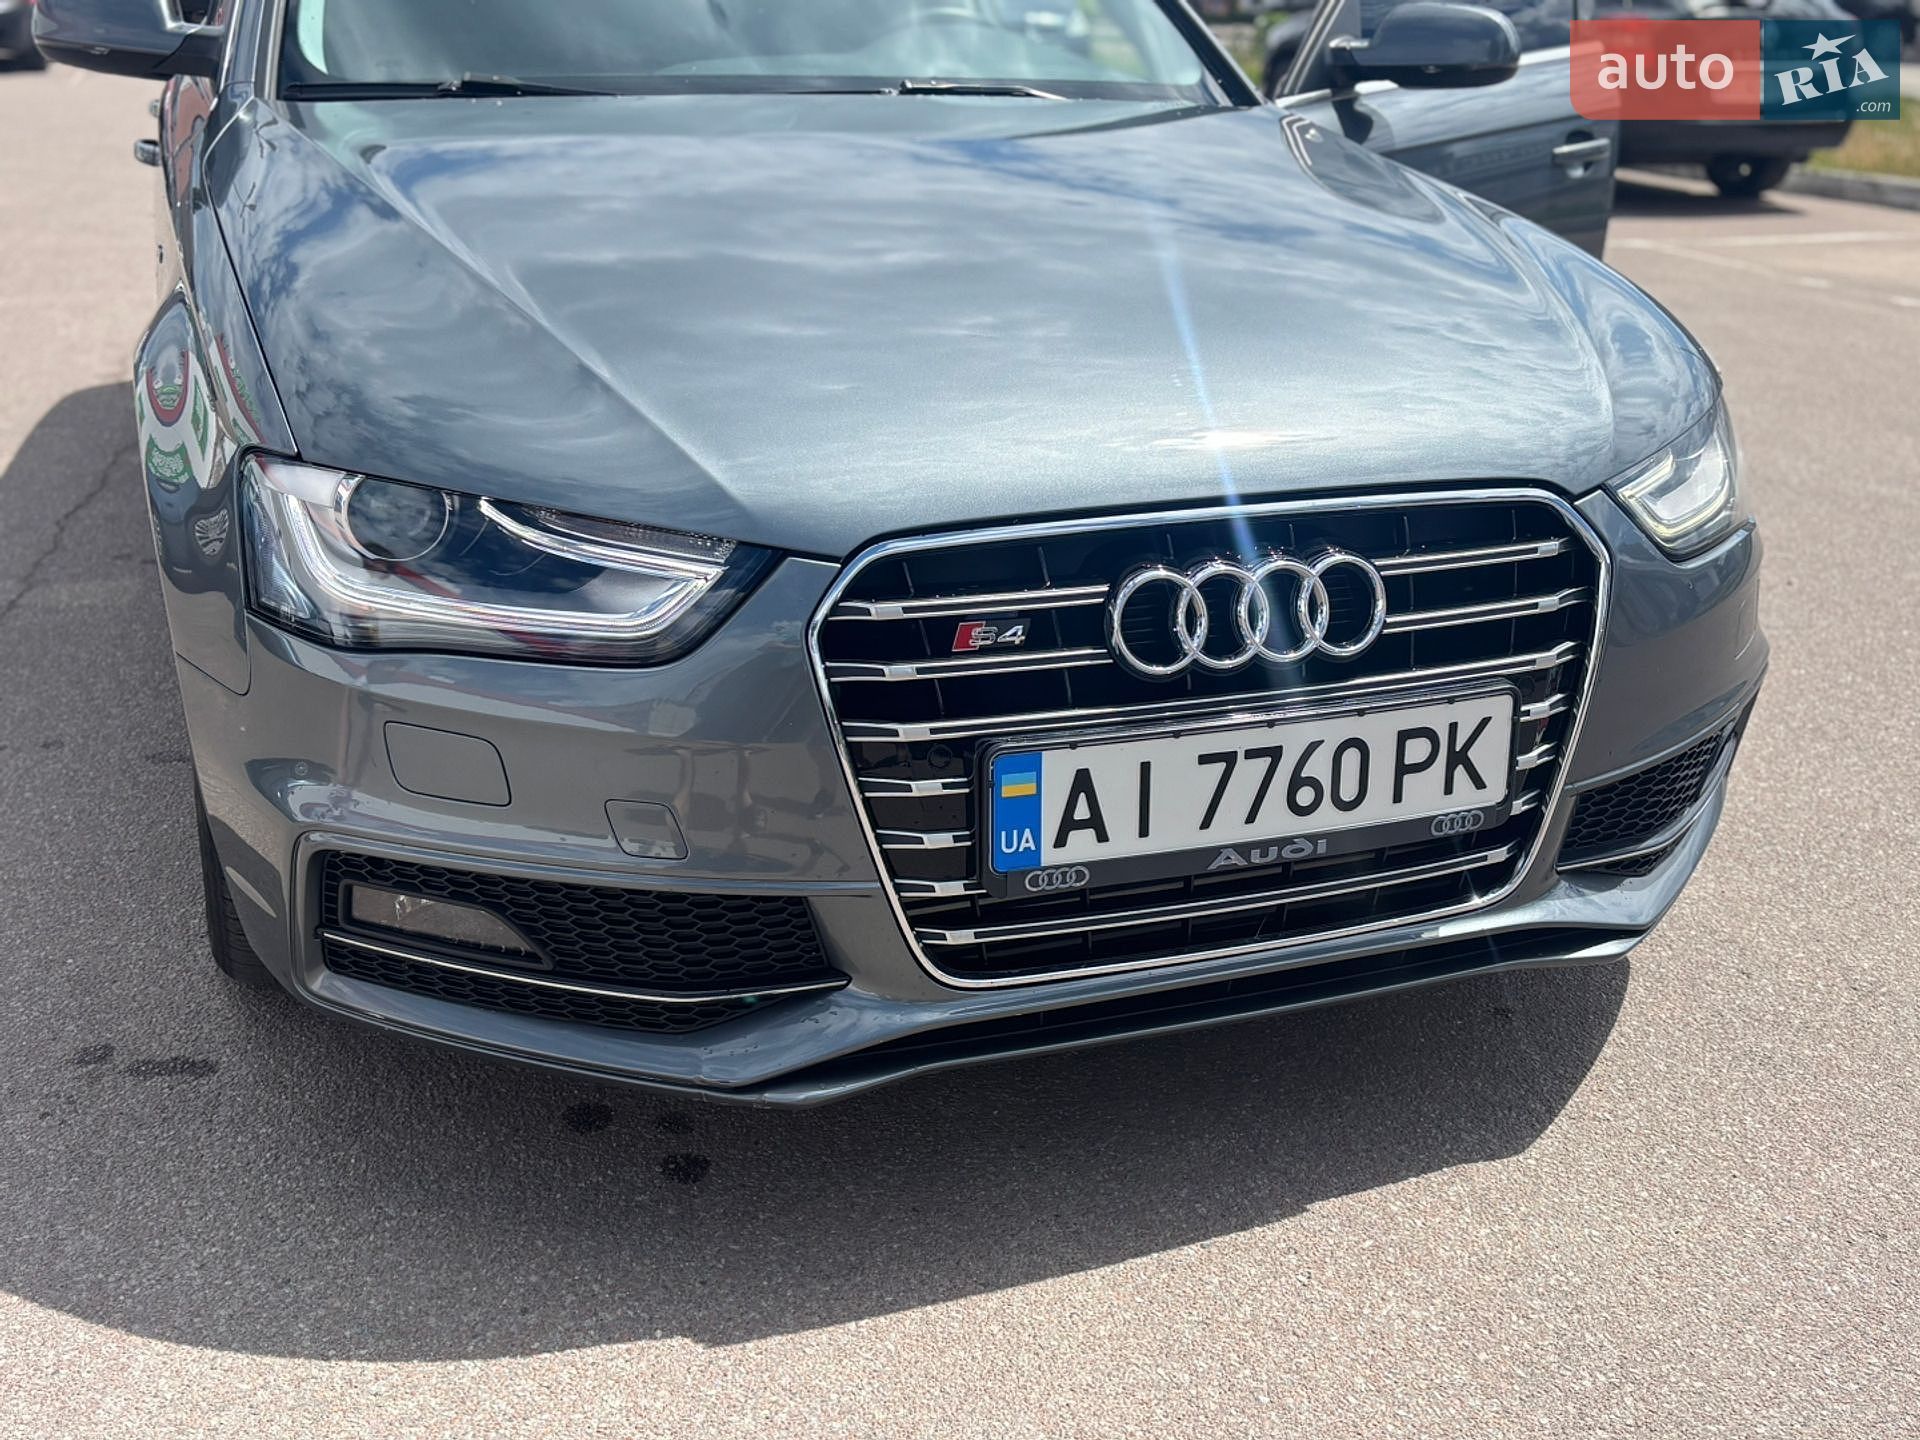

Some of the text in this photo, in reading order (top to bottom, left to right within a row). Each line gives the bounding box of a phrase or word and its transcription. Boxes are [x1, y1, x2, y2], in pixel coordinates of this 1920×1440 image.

[968, 625, 1026, 647] S4
[1053, 716, 1493, 849] AI 7760 PK
[1001, 828, 1036, 854] UA
[1207, 838, 1328, 870] Audi
